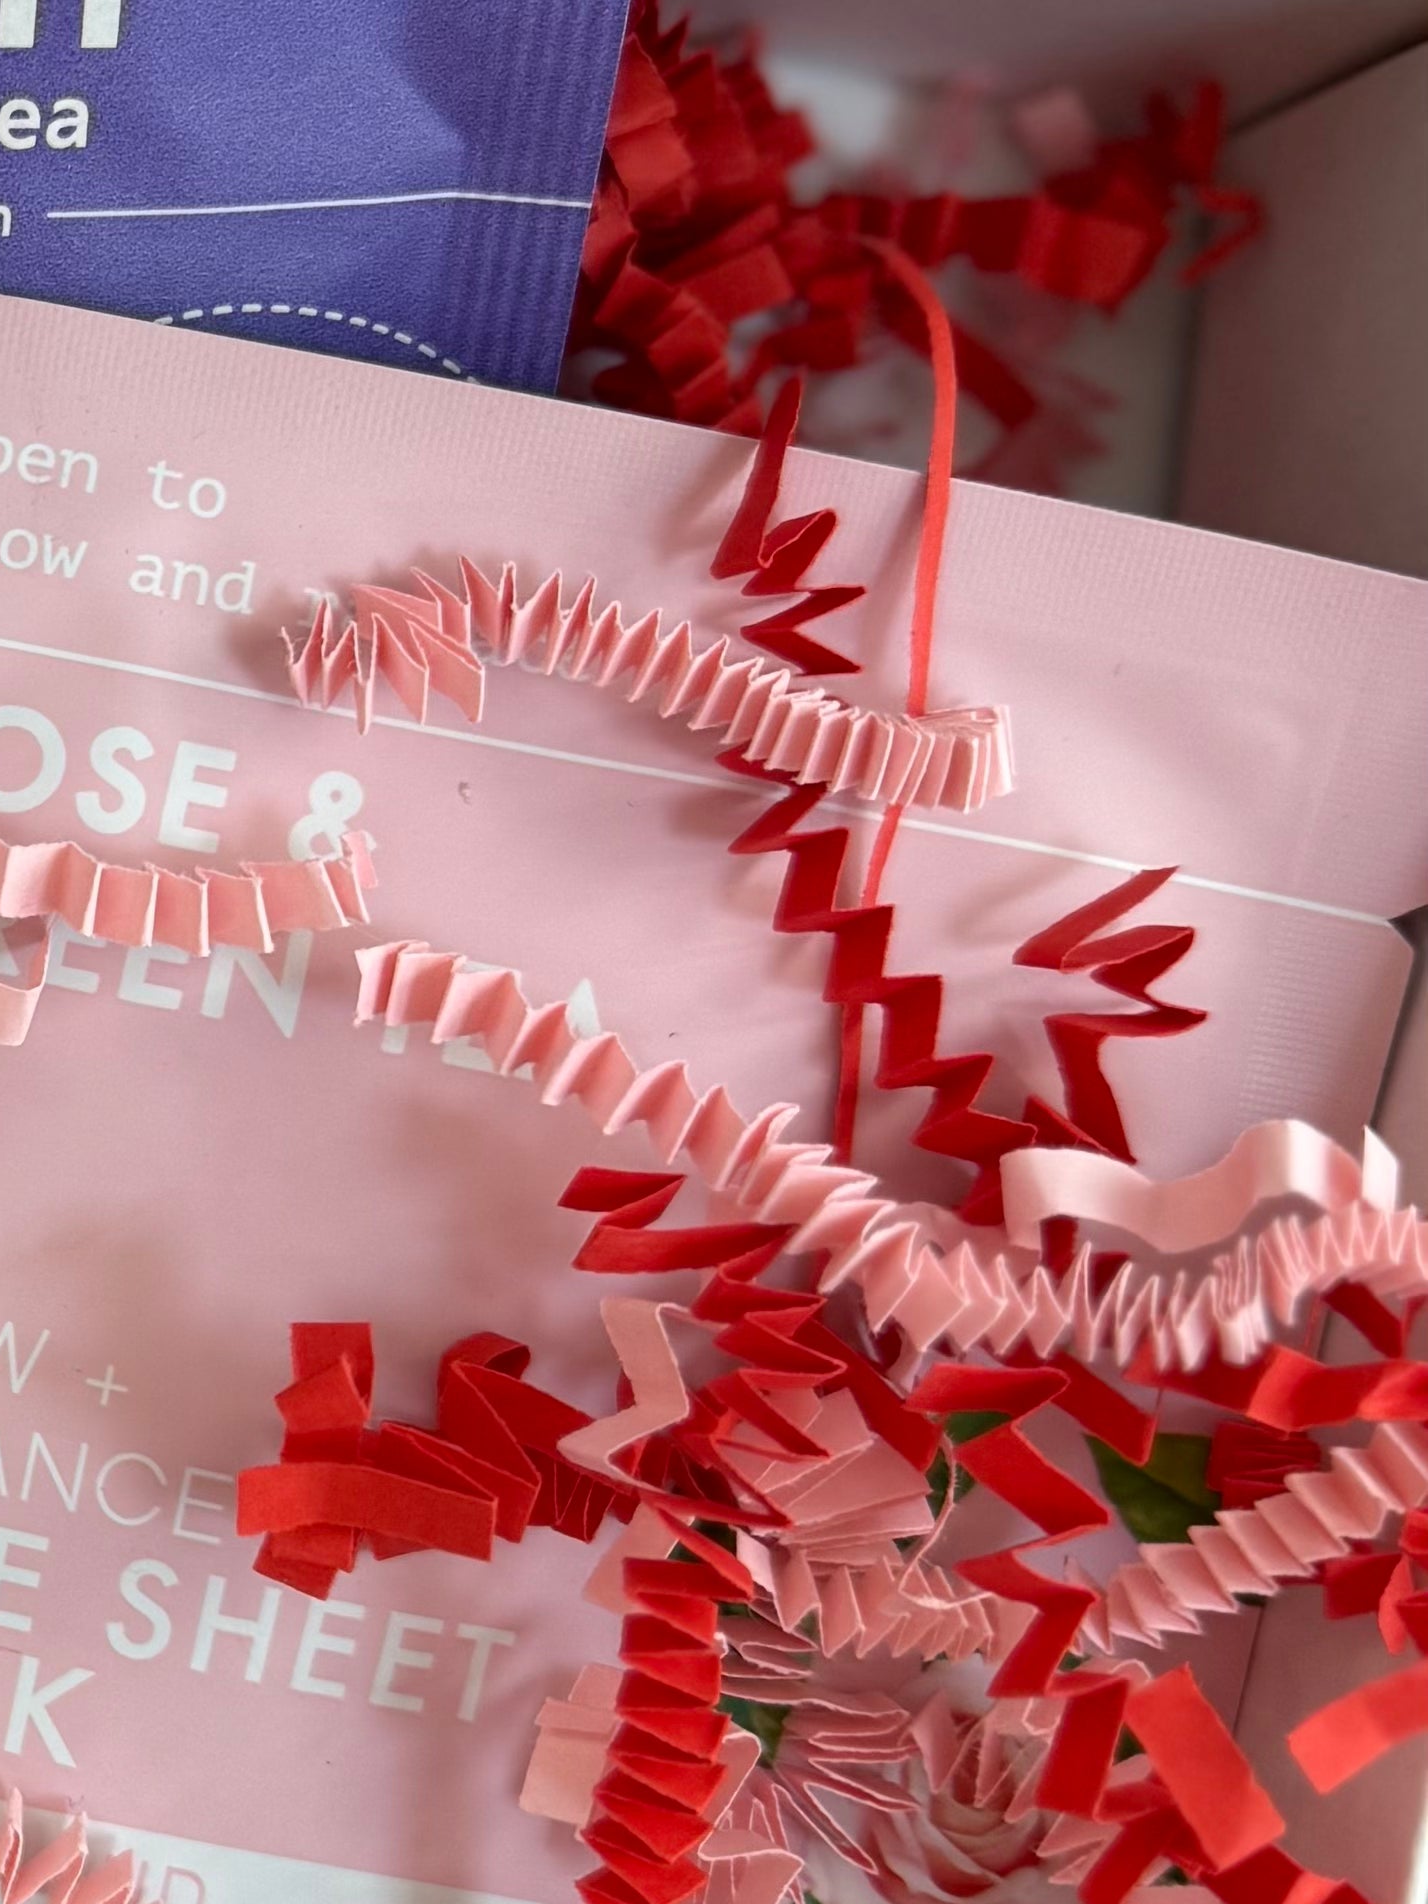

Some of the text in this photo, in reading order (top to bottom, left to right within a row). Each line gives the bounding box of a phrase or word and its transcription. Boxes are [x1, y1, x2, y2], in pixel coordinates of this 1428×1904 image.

[147, 459, 228, 520] to
[129, 553, 258, 615] and
[105, 1558, 516, 1723] SHEET
